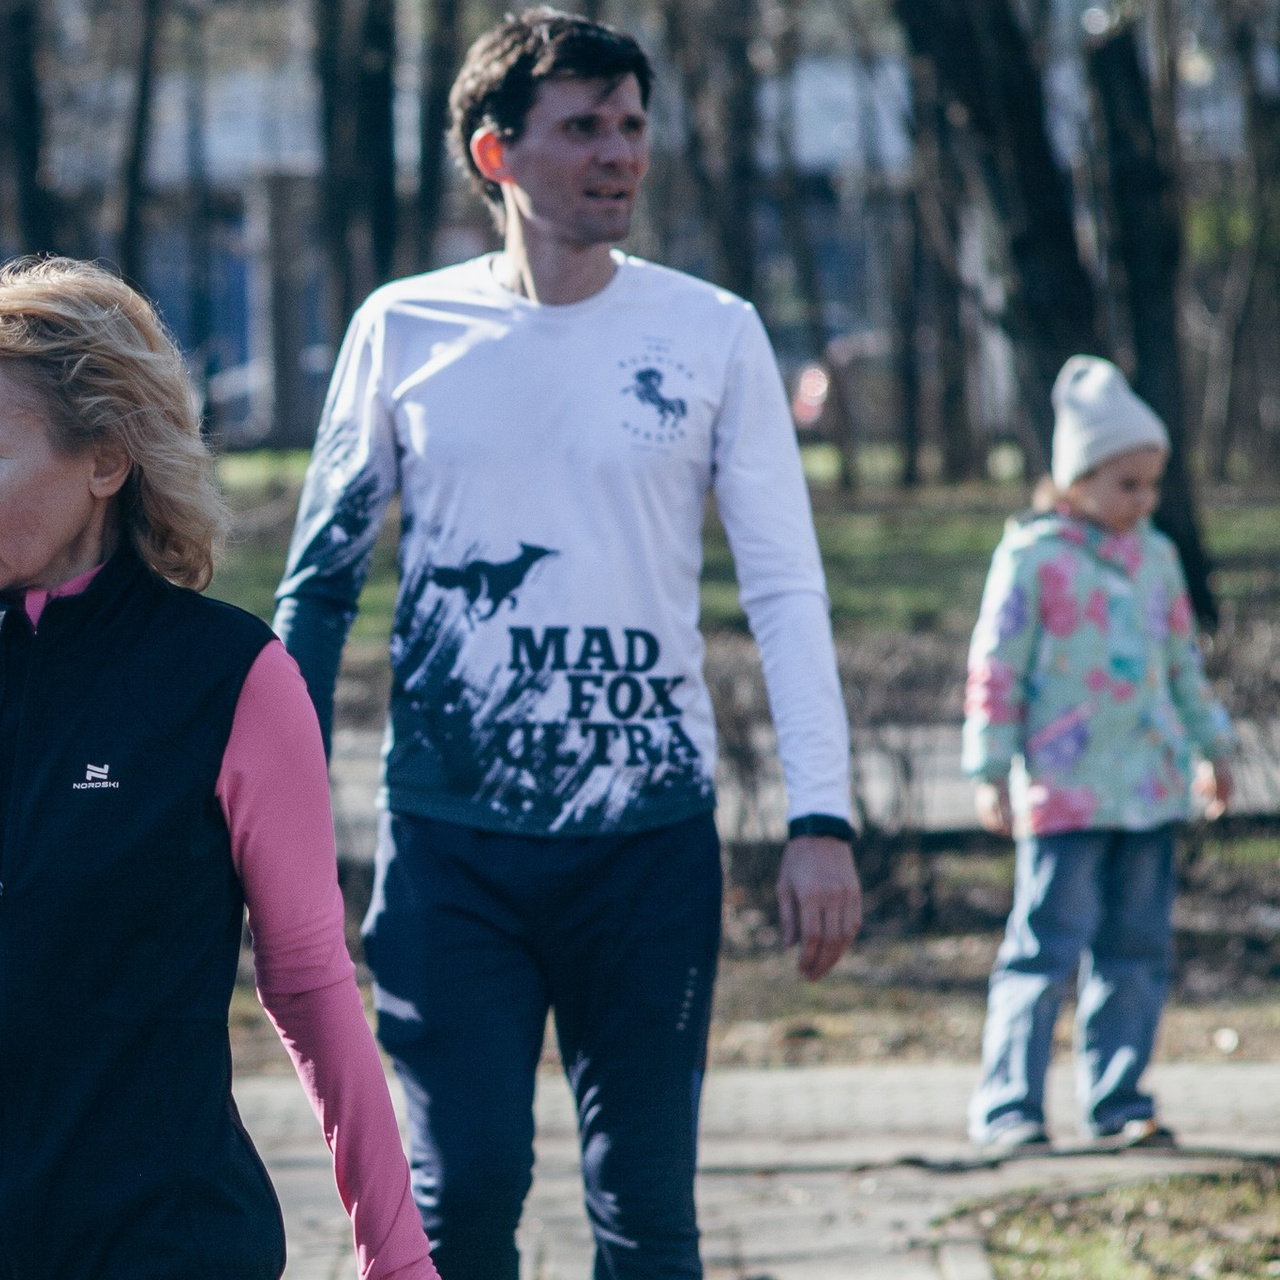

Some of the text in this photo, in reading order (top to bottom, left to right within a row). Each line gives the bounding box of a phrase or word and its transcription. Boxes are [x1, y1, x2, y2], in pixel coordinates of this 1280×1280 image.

[507, 626, 660, 673] MAD
[566, 675, 685, 720] FOX
[493, 720, 700, 767] ULTRA
[72, 781, 119, 789] NORDSKI
